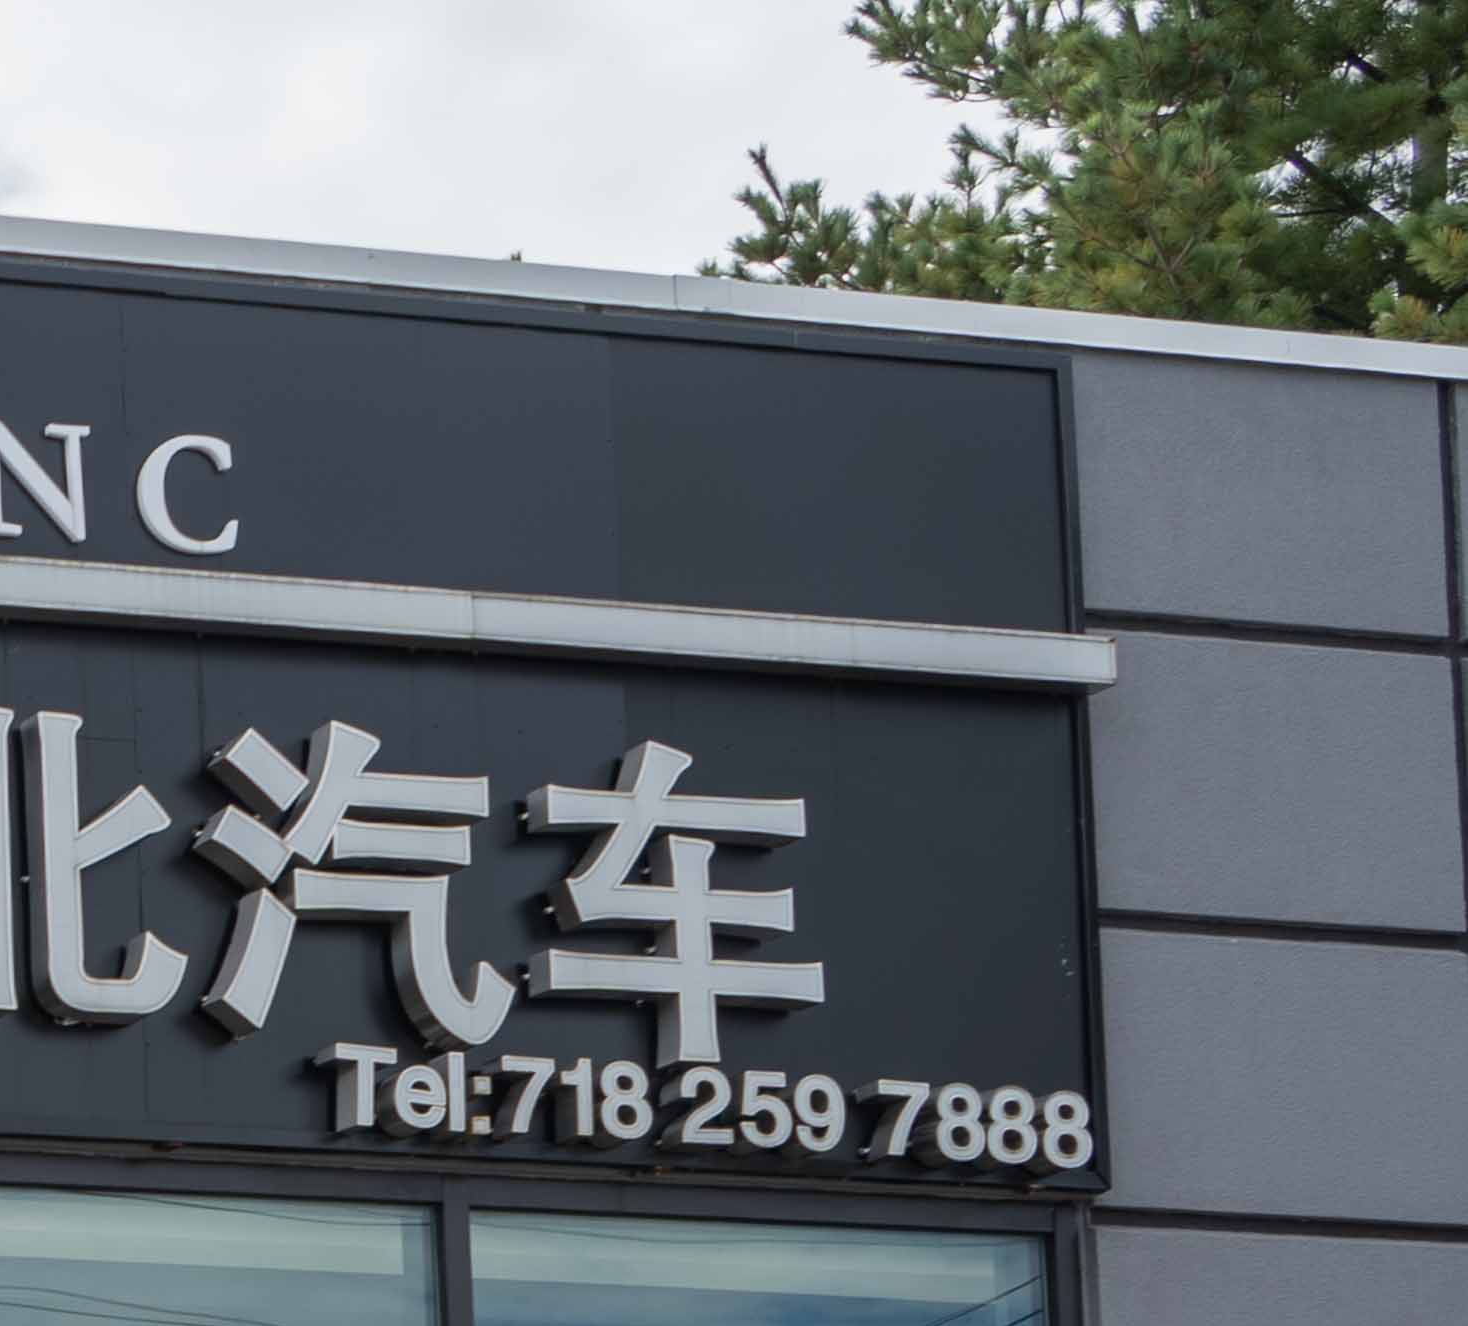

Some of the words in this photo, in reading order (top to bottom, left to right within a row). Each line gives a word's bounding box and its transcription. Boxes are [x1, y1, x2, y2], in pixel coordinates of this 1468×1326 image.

[320, 1041, 653, 1142] Tel:718
[676, 1065, 847, 1153] 259
[866, 1078, 1094, 1170] 7888
